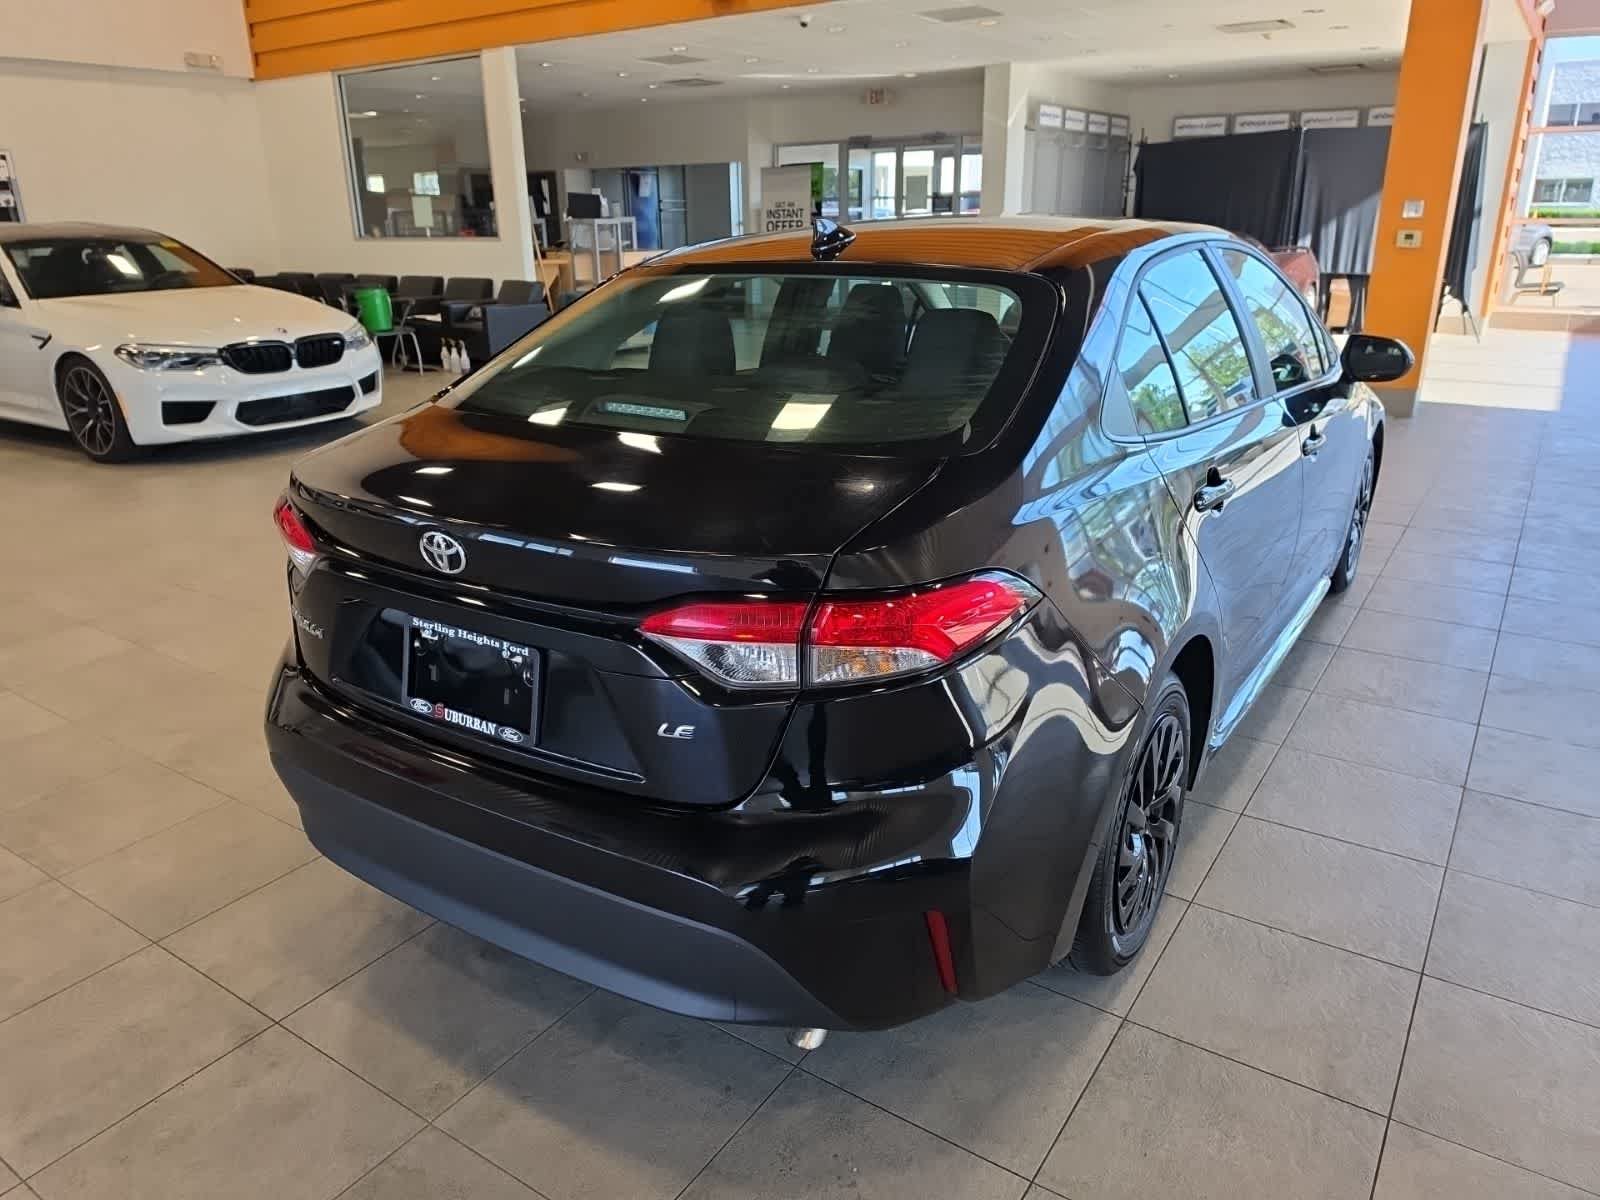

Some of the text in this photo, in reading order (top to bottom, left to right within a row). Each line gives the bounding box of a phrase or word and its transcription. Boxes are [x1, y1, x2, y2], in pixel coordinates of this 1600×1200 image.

[766, 208, 803, 219] INSTANT
[412, 617, 529, 656] Sterling Heights Ford
[434, 703, 497, 735] SUBURBAN
[657, 722, 695, 740] LE
